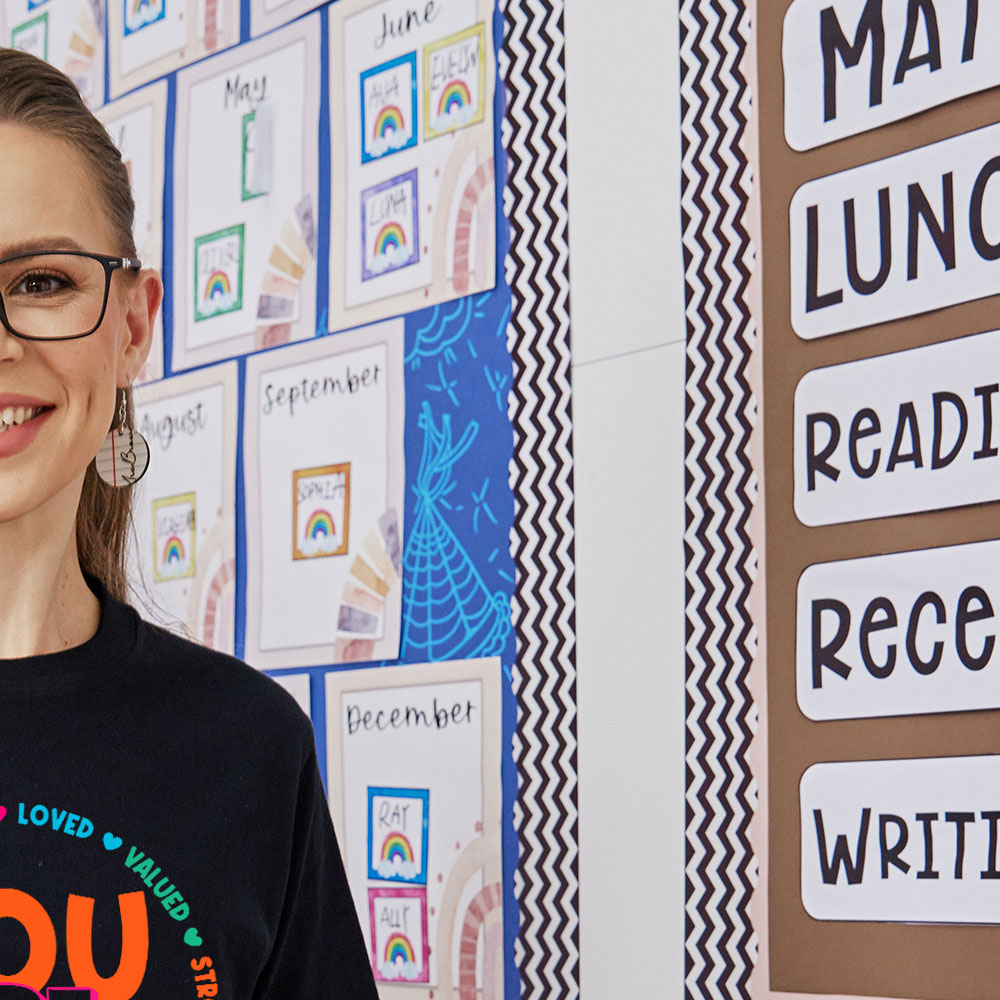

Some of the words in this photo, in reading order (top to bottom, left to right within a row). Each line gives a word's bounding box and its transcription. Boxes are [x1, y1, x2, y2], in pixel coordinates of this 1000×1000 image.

[374, 0, 438, 49] June
[224, 75, 267, 109] May
[263, 364, 382, 416] September
[140, 403, 208, 450] August
[347, 699, 475, 734] December
[18, 803, 94, 838] LOVED
[813, 808, 1000, 885] WRITI
[124, 846, 189, 922] VALUED
